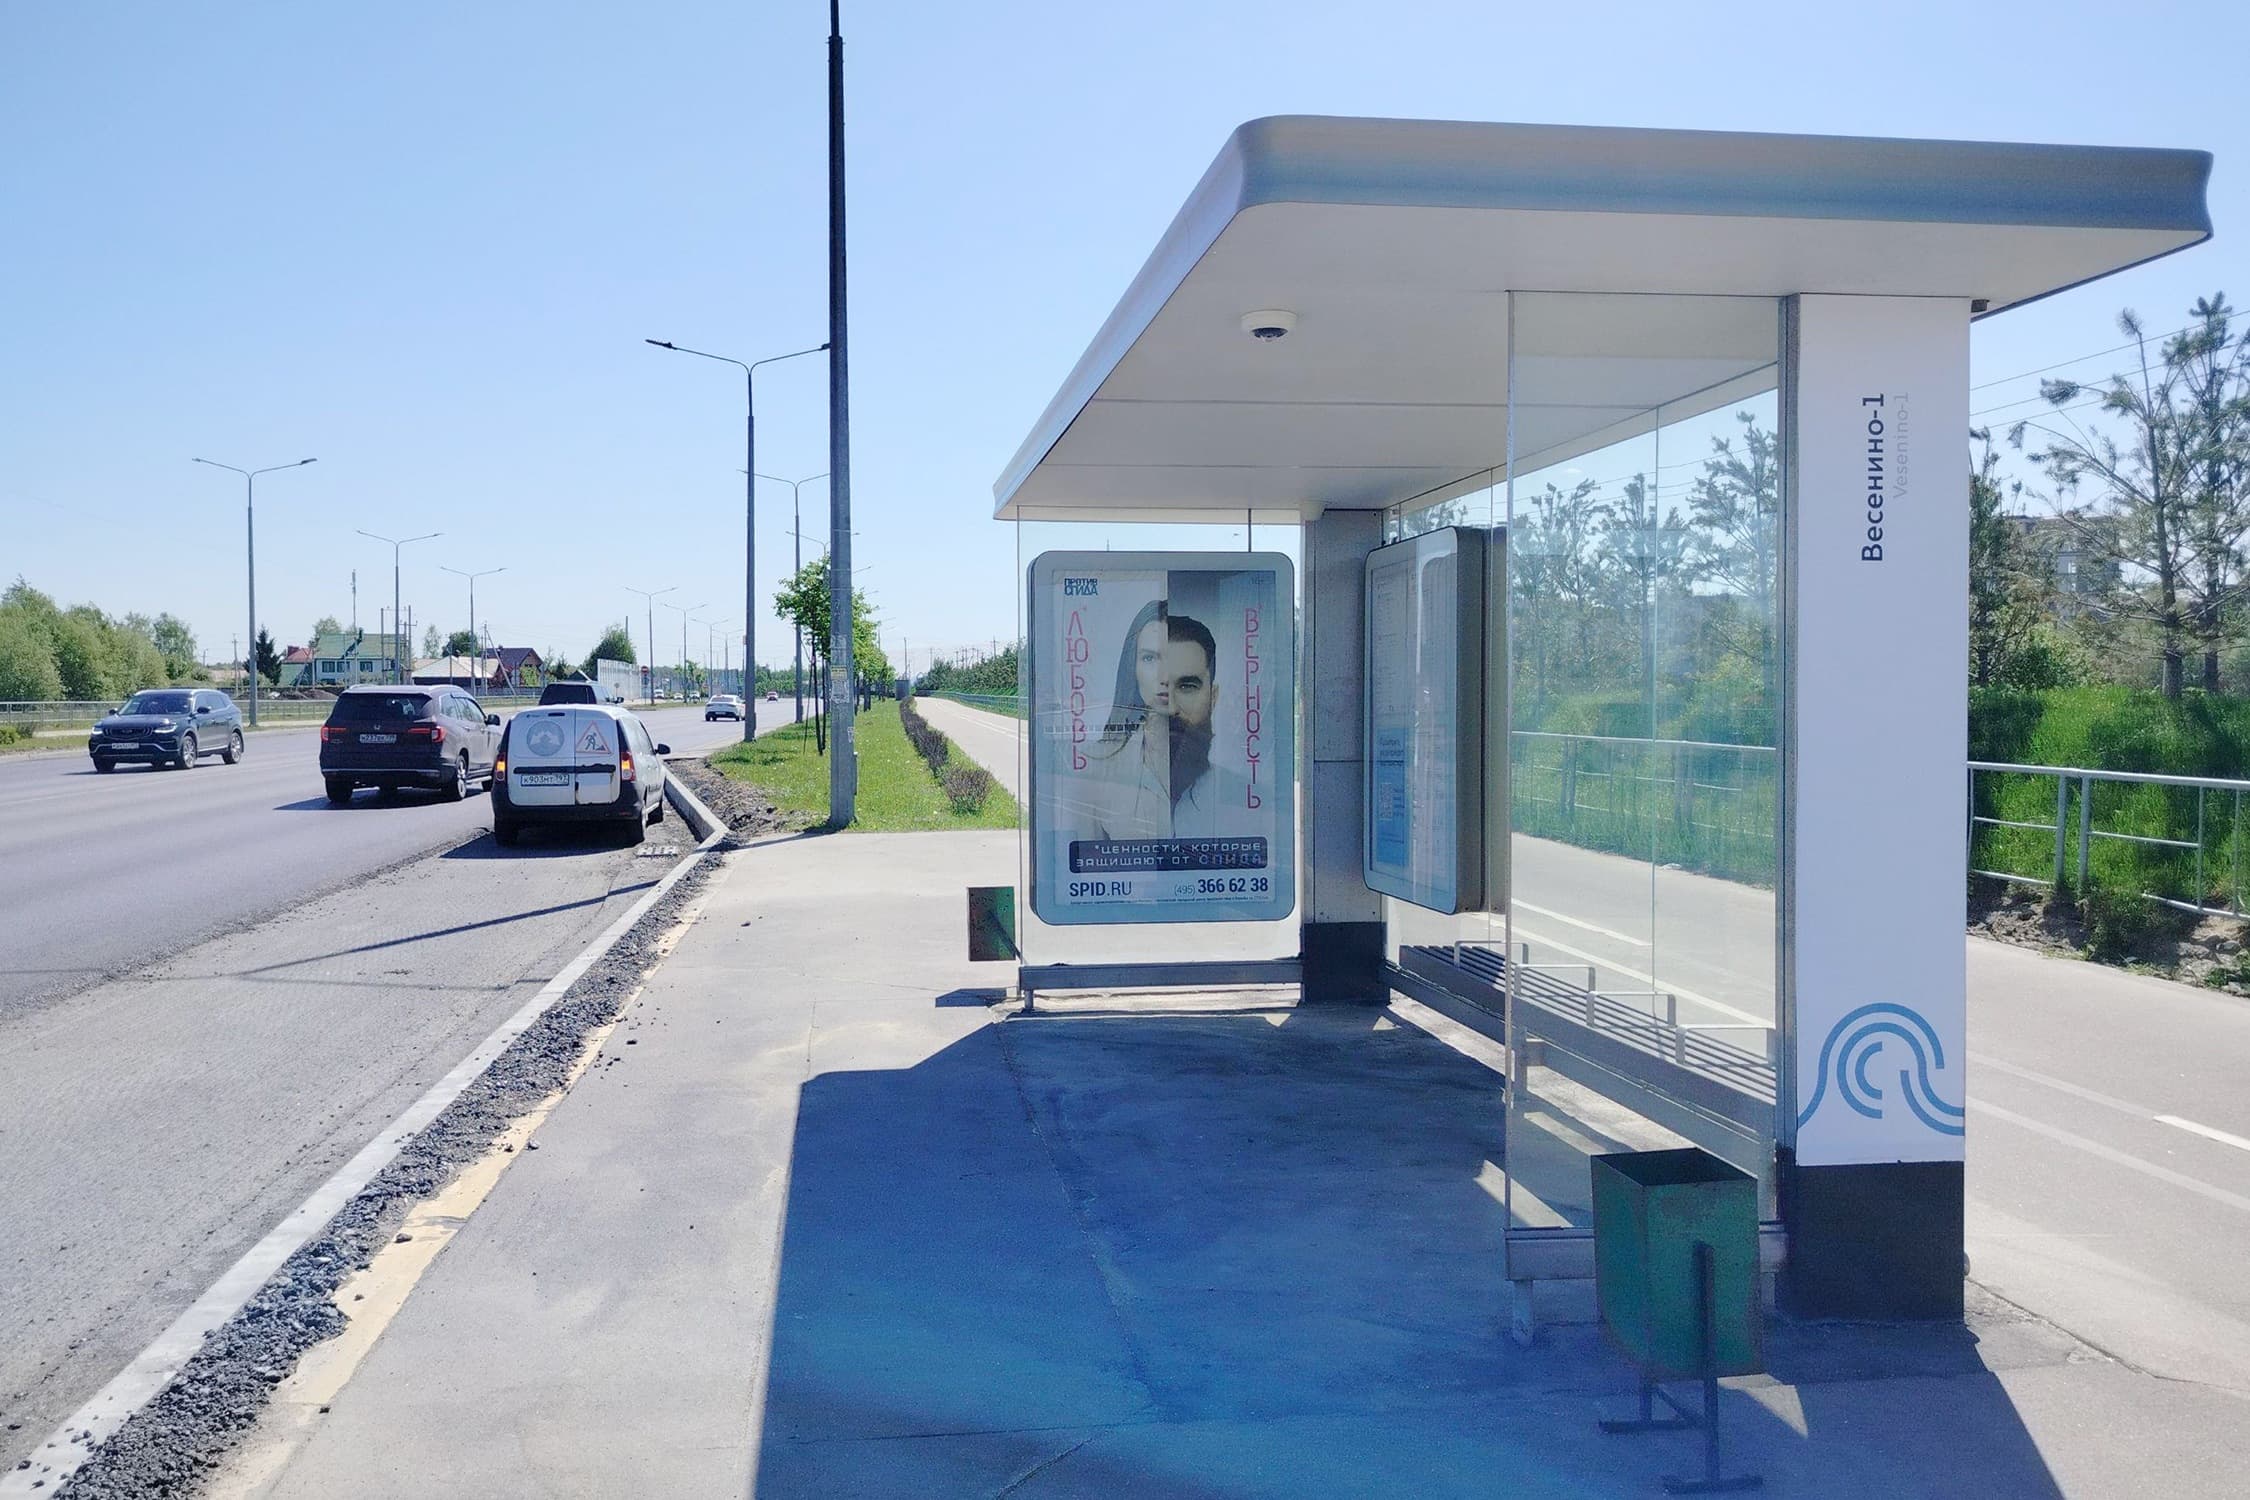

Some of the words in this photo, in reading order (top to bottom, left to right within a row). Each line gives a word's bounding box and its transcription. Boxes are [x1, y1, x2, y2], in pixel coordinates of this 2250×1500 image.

[1893, 392, 1909, 499] Vesenino-1
[1861, 393, 1884, 561] Весенино-1
[1064, 578, 1097, 587] ПРОТИВ
[1064, 585, 1098, 596] СПИДА
[1192, 843, 1260, 852] КОТОРЫЕ
[1076, 857, 1163, 867] ЗАЩИЩАЮТ
[1172, 856, 1189, 864] ОТ
[1069, 881, 1132, 897] SPID.RU
[1174, 884, 1195, 896] (495)
[1198, 878, 1225, 893] 366
[1229, 878, 1246, 892] 62
[1250, 877, 1268, 892] 38
